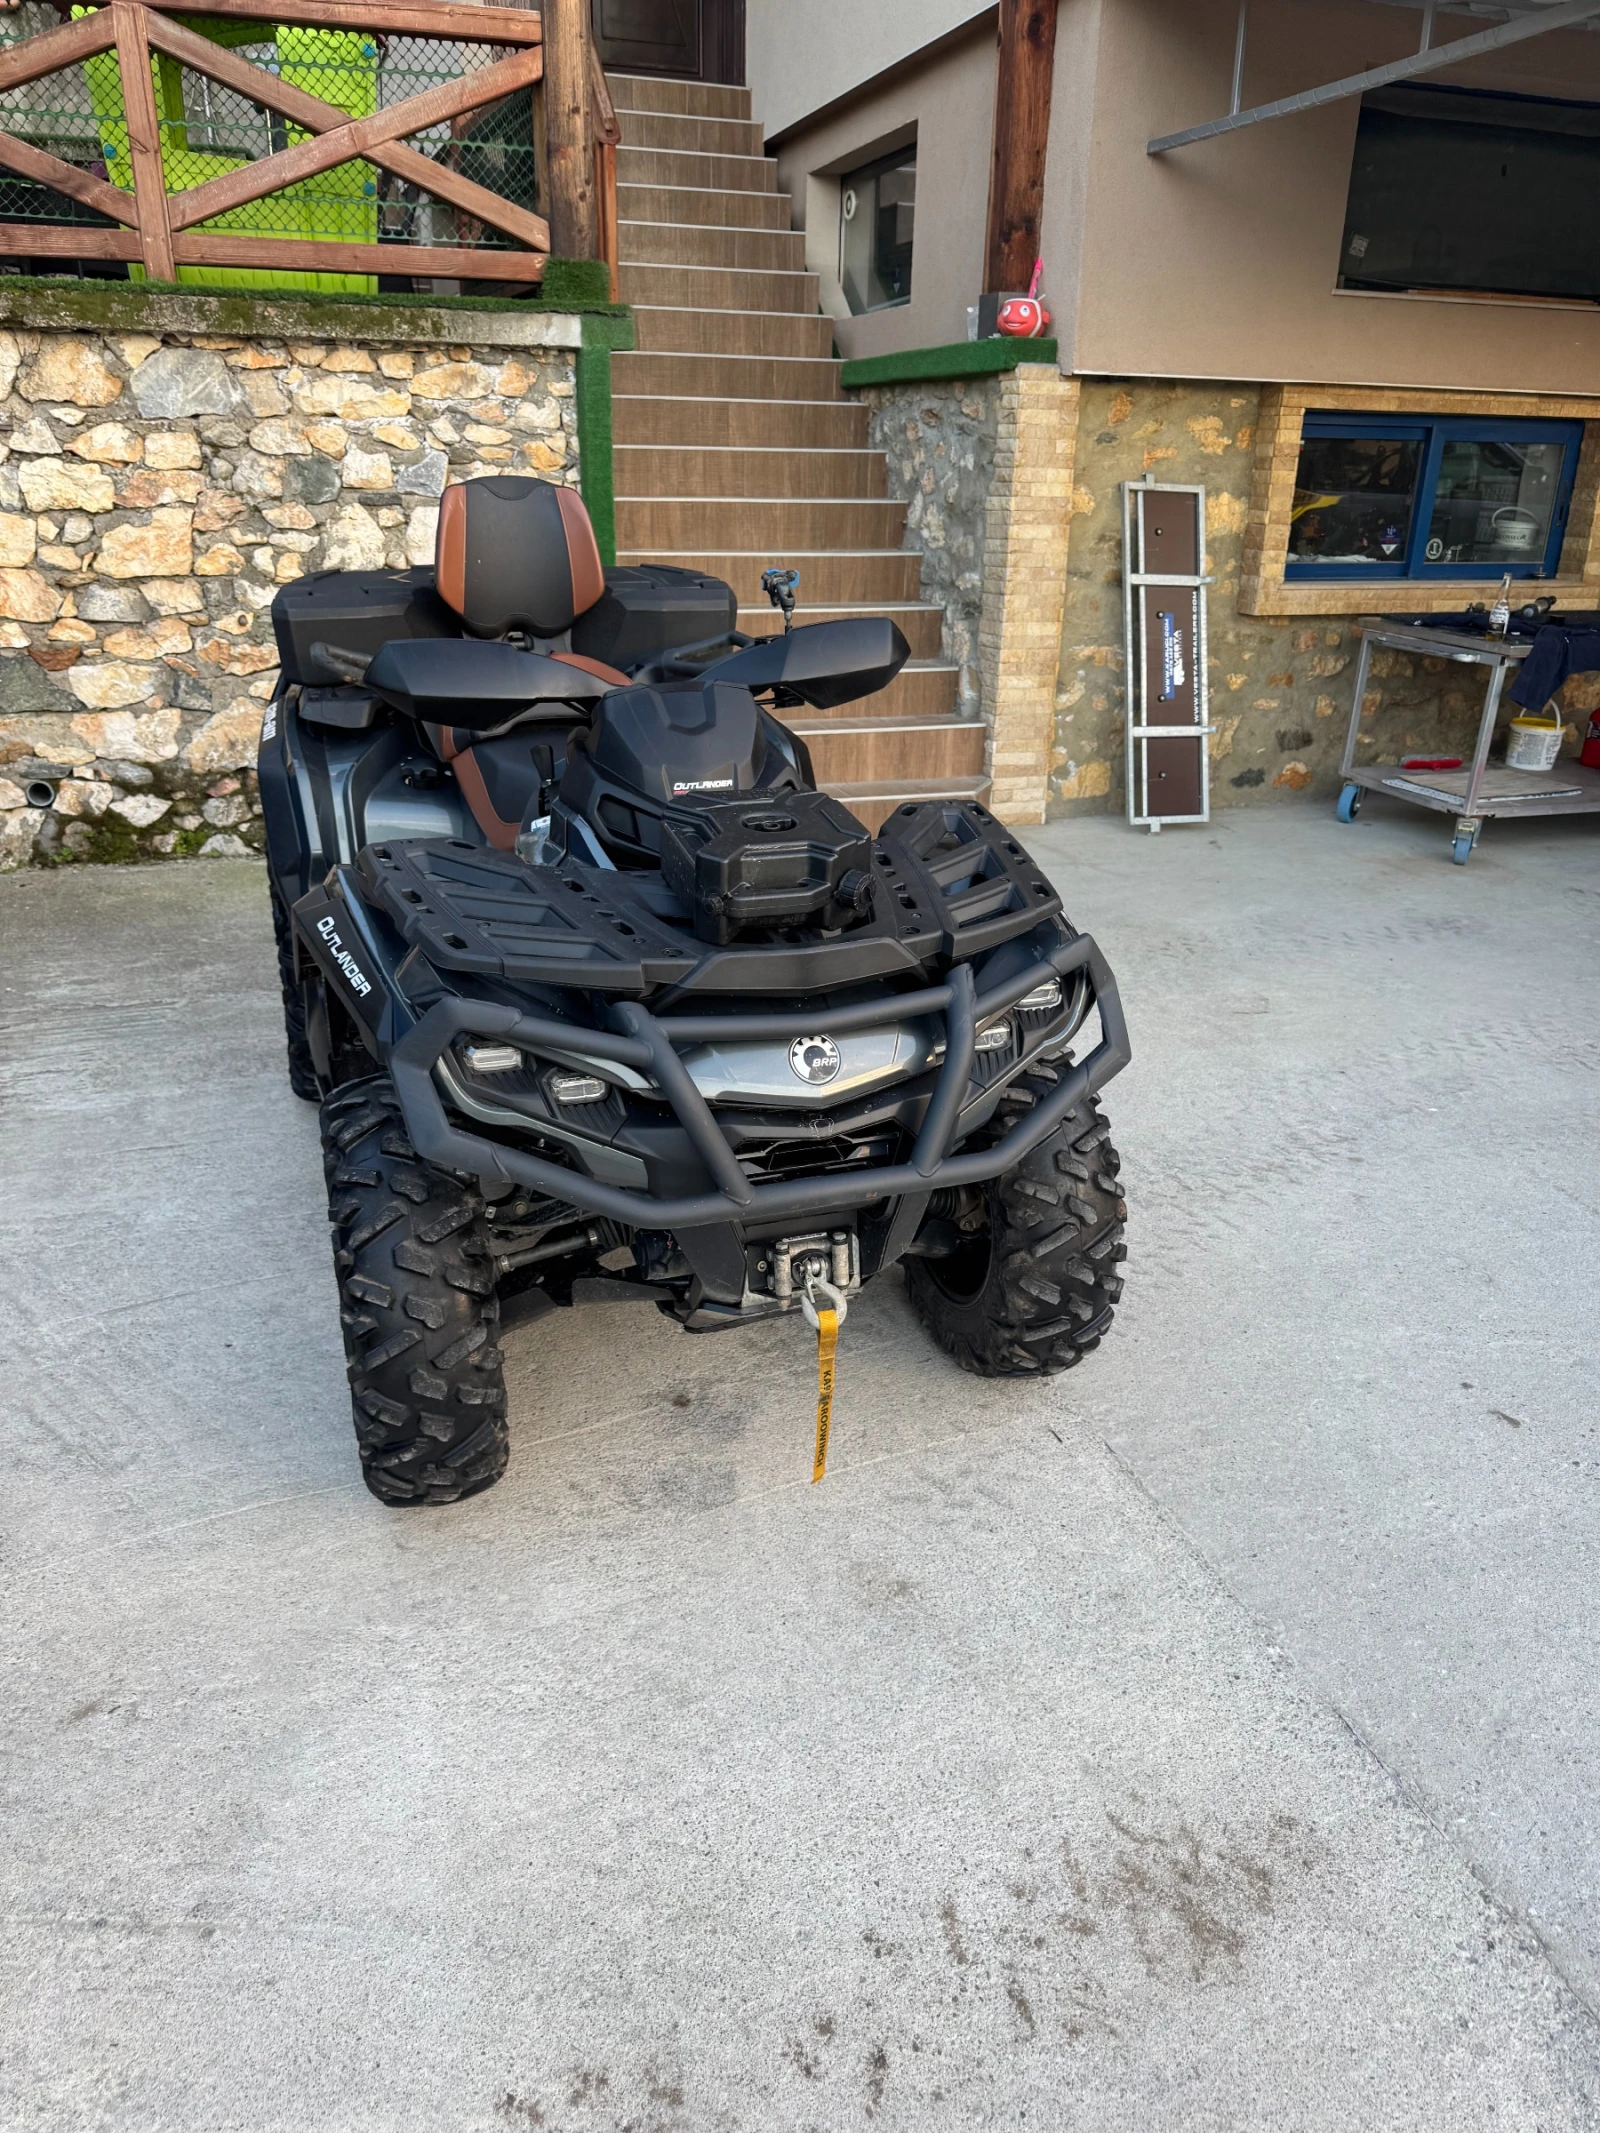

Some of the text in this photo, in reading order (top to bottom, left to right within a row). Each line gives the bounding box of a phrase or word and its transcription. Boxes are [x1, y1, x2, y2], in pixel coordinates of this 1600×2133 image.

[673, 779, 733, 790] OUTLANDER
[316, 916, 372, 998] OUTLANDER
[812, 1057, 837, 1067] BRP
